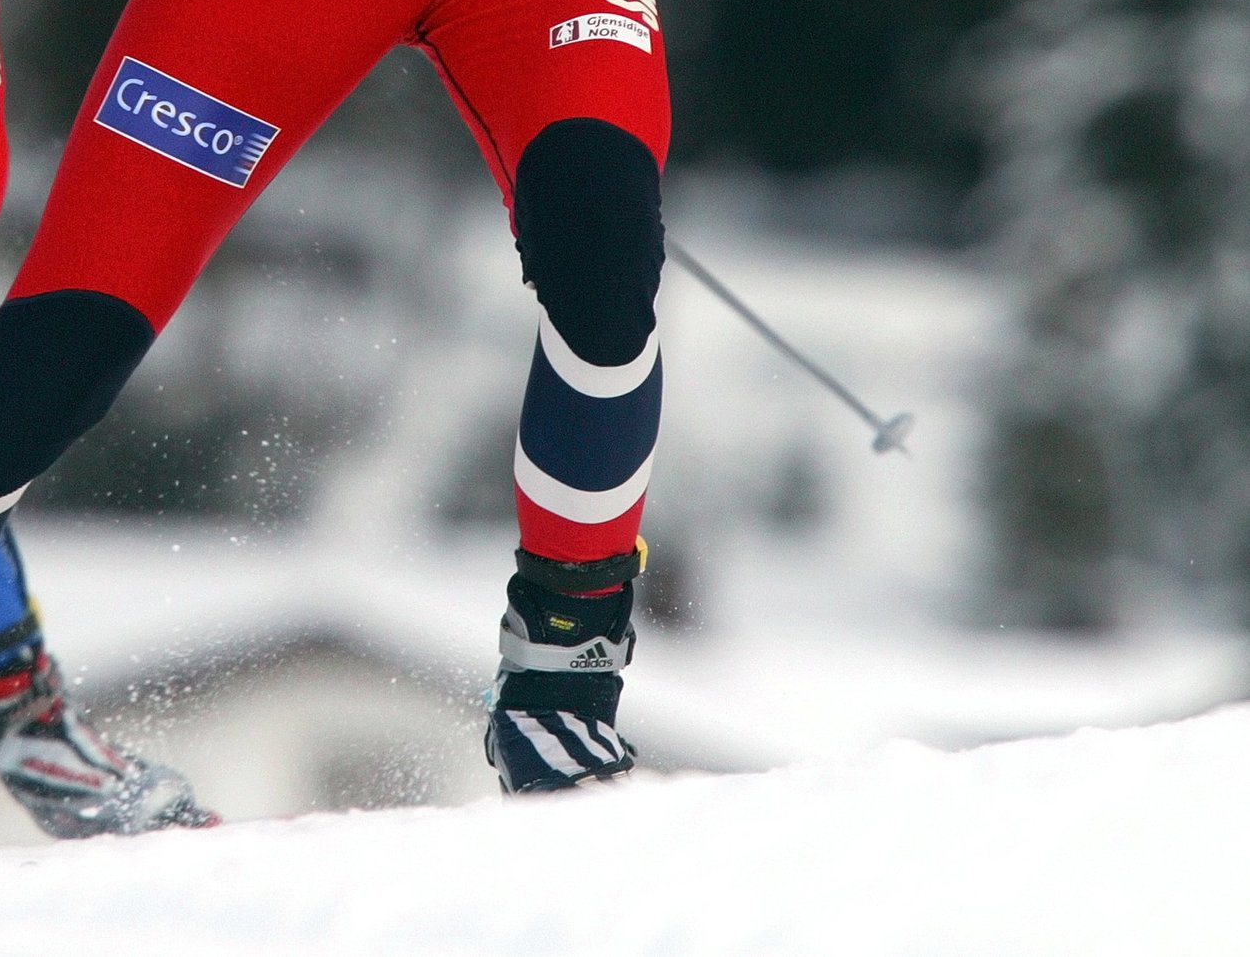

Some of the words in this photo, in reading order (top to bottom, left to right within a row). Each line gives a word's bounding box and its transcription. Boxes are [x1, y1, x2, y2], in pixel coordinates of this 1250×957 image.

[587, 16, 648, 39] Gjensidige
[588, 28, 619, 38] NOR
[116, 78, 234, 156] Cresco
[570, 658, 613, 669] adidas
